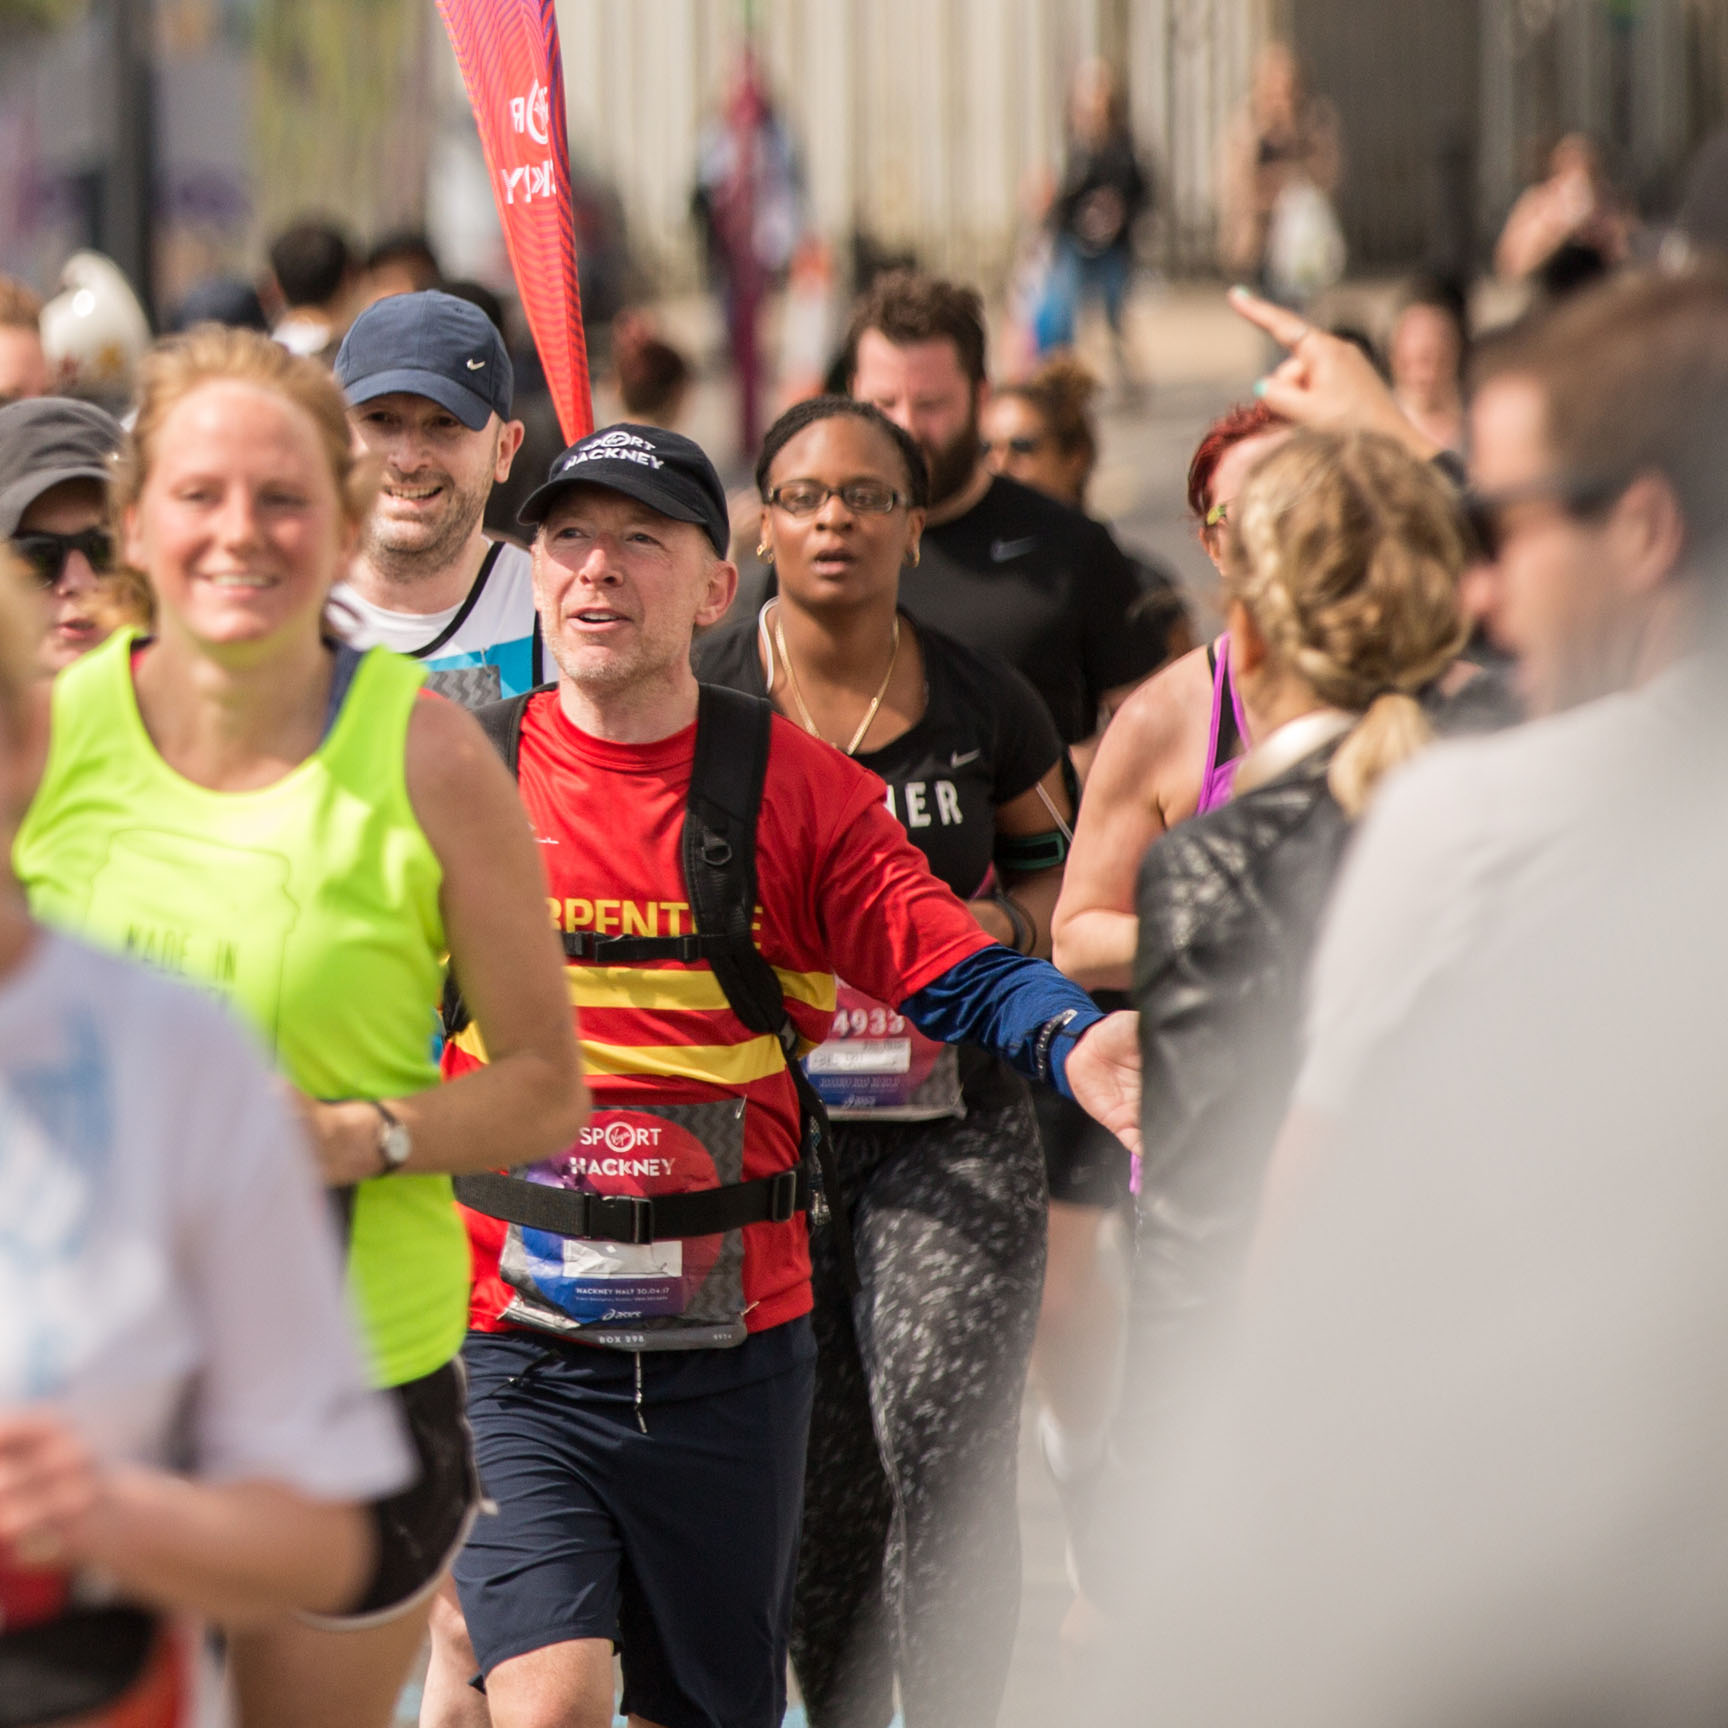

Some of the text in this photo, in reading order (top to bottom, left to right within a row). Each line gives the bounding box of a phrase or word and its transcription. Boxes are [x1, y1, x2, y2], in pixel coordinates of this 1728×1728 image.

[561, 446, 665, 472] HACKNEY
[578, 1121, 663, 1153] SPORT
[568, 1156, 676, 1177] HACKNEY
[575, 1287, 613, 1295] HACKNEY
[598, 1335, 622, 1344] BOX
